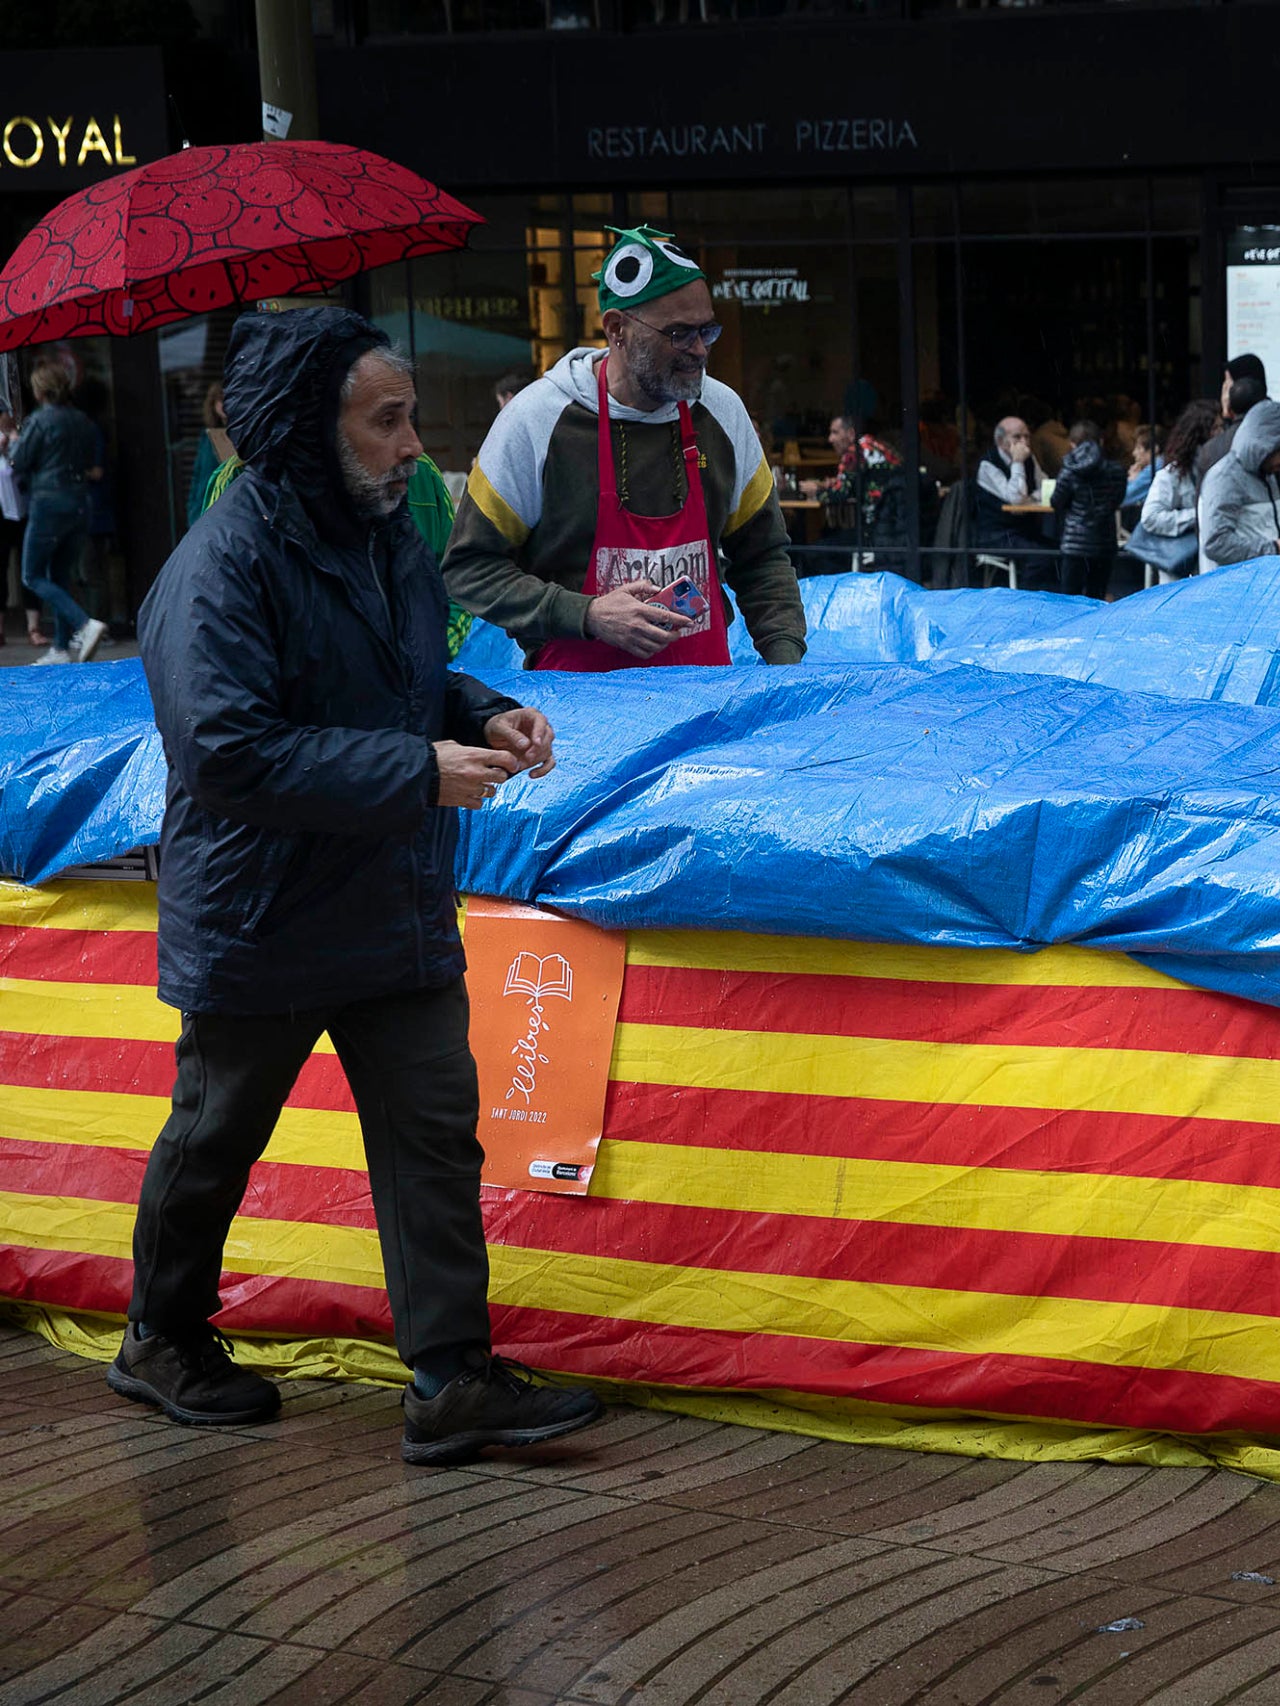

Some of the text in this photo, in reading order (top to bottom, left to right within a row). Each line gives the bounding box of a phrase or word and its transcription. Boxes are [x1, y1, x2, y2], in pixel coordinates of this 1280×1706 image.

[0, 114, 137, 167] OYAL
[587, 119, 918, 158] RESTAURANT PIZZERIA
[603, 552, 708, 591] Arkham
[491, 1107, 547, 1124] SANT JORDI 2022
